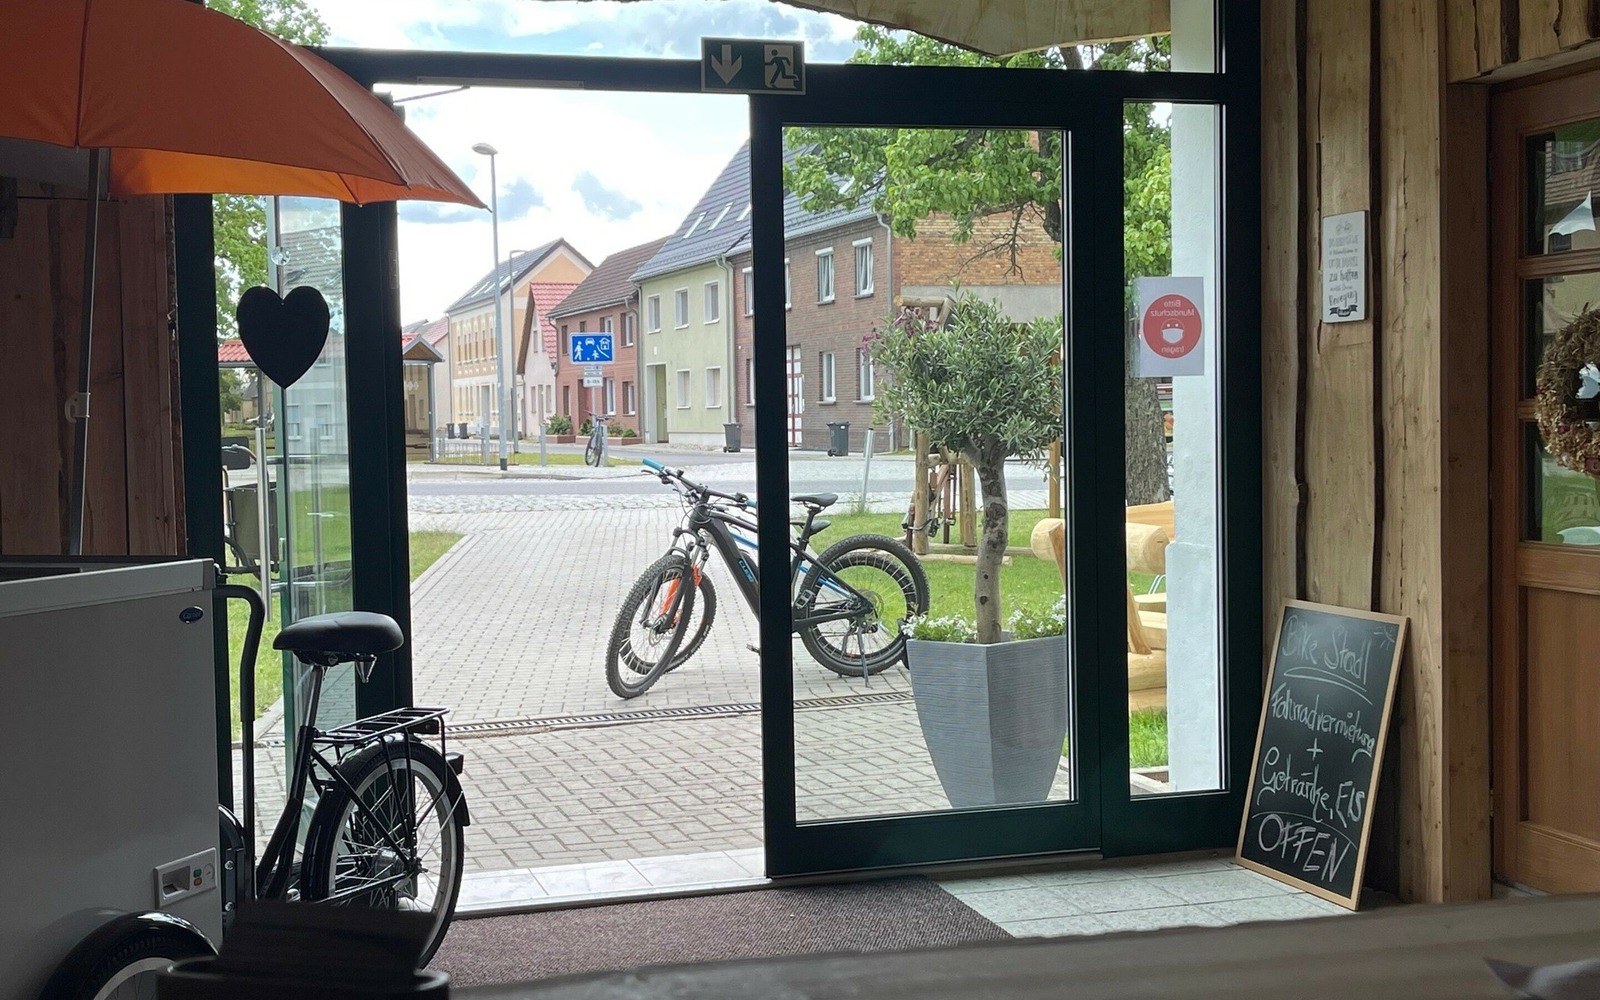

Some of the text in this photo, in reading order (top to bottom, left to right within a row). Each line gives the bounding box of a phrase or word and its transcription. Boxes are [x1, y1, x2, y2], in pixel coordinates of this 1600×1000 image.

[1282, 614, 1373, 685] Bike Stadl
[1258, 813, 1351, 883] OFFEN
